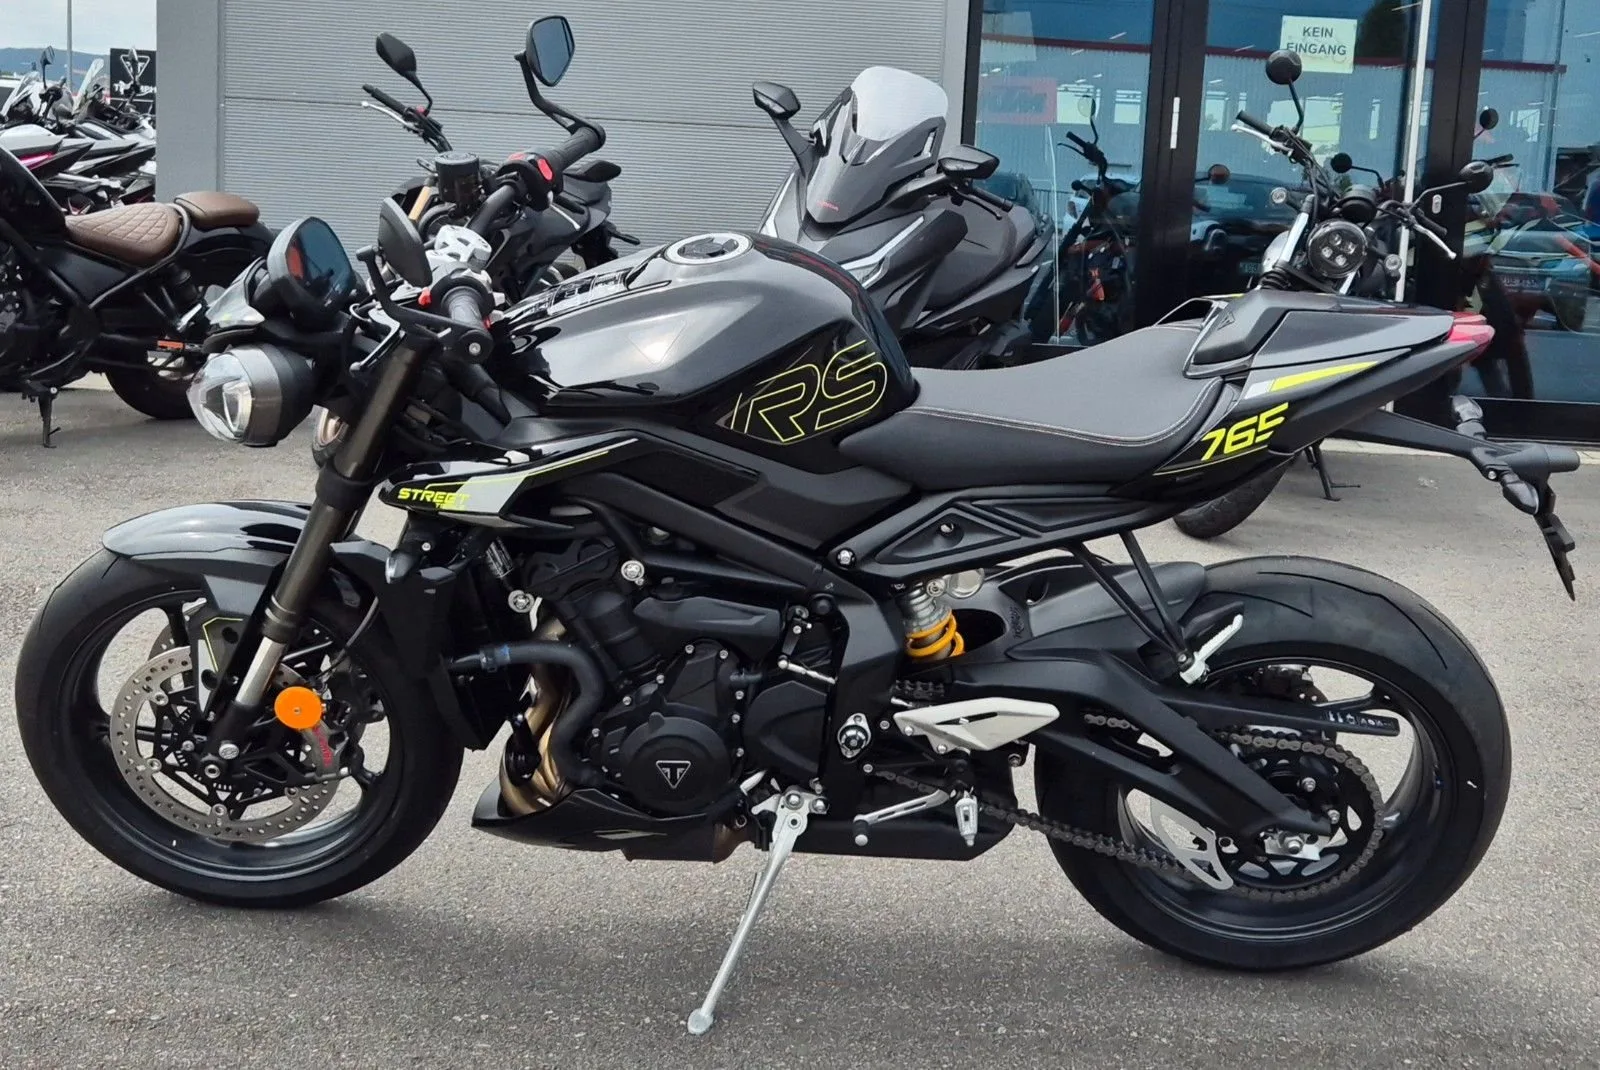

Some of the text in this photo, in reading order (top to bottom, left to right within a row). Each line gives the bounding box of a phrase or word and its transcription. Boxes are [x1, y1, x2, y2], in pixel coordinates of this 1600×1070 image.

[1302, 26, 1334, 38] KEIN
[1286, 42, 1347, 56] EINGANG
[730, 339, 888, 443] RS
[1201, 402, 1289, 462] 765
[397, 487, 470, 505] STREET
